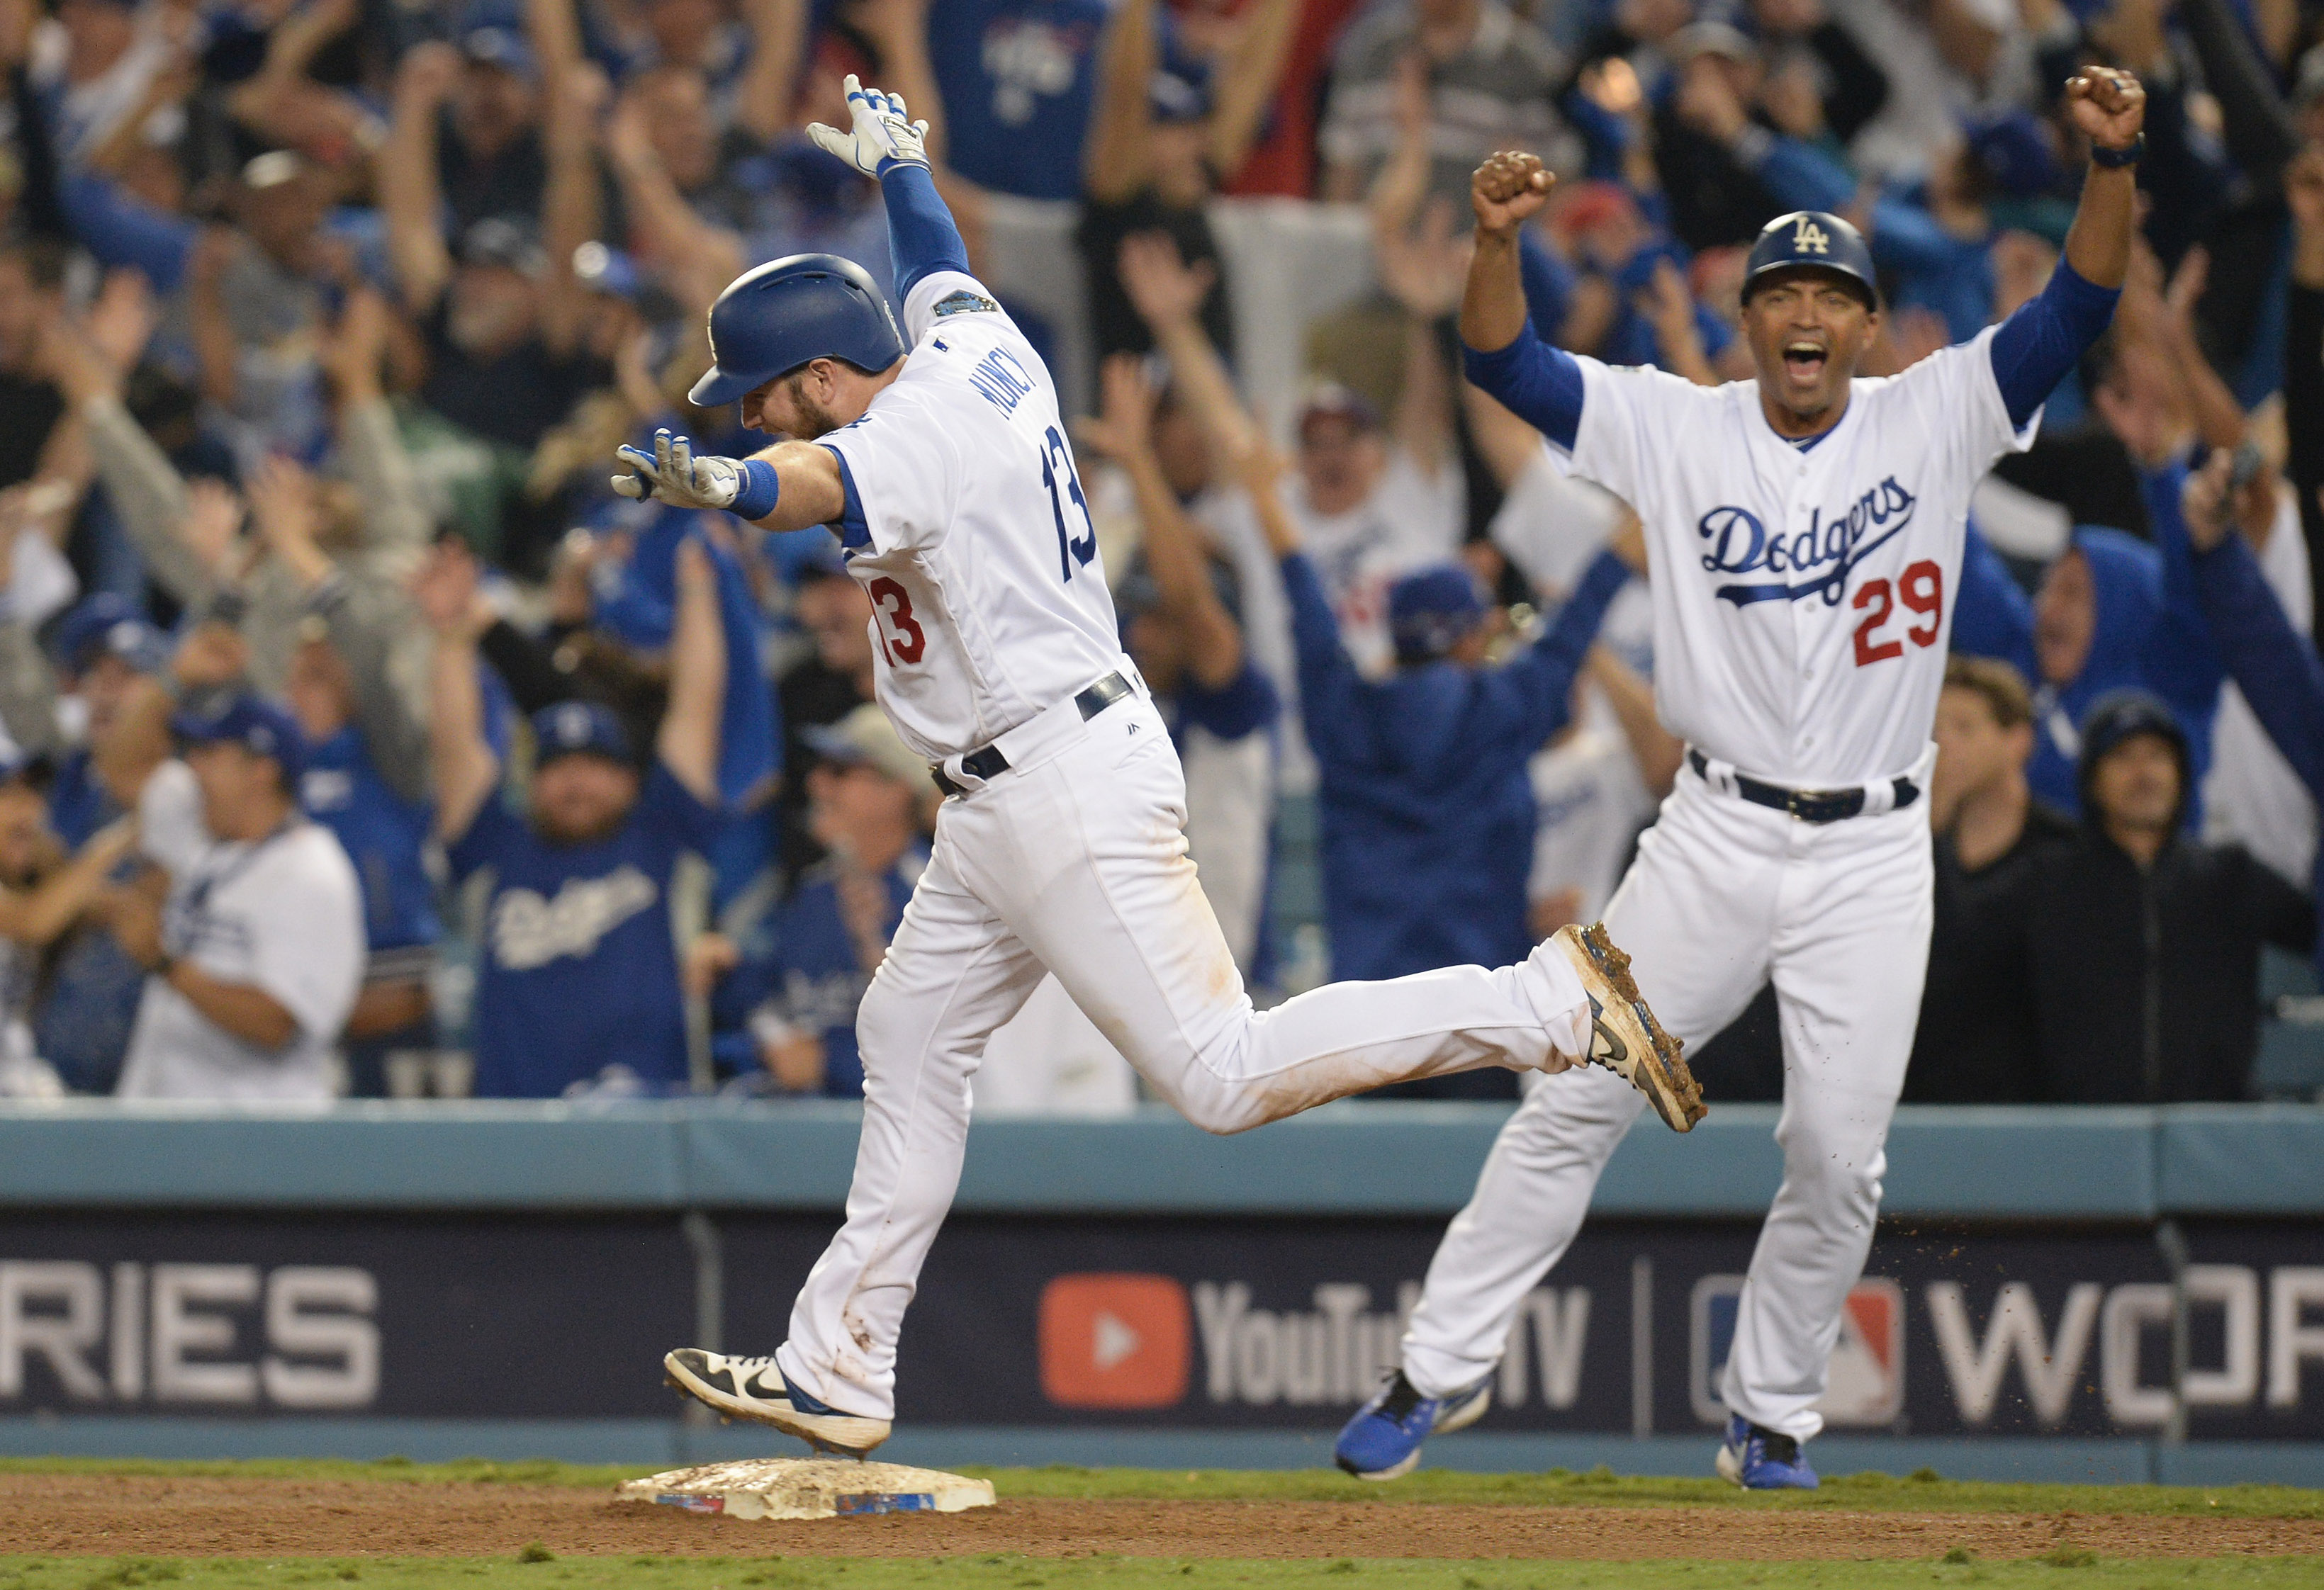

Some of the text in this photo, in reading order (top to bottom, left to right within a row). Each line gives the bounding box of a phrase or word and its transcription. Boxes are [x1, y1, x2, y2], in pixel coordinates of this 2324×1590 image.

[1792, 215, 1829, 254] LA
[968, 344, 1036, 421] MUNCY
[1040, 425, 1096, 584] 13
[1698, 475, 1916, 607] Dodgers
[1852, 558, 1943, 667] 29
[0, 1259, 380, 1407] RIES
[1193, 1280, 1419, 1406] YouTu
